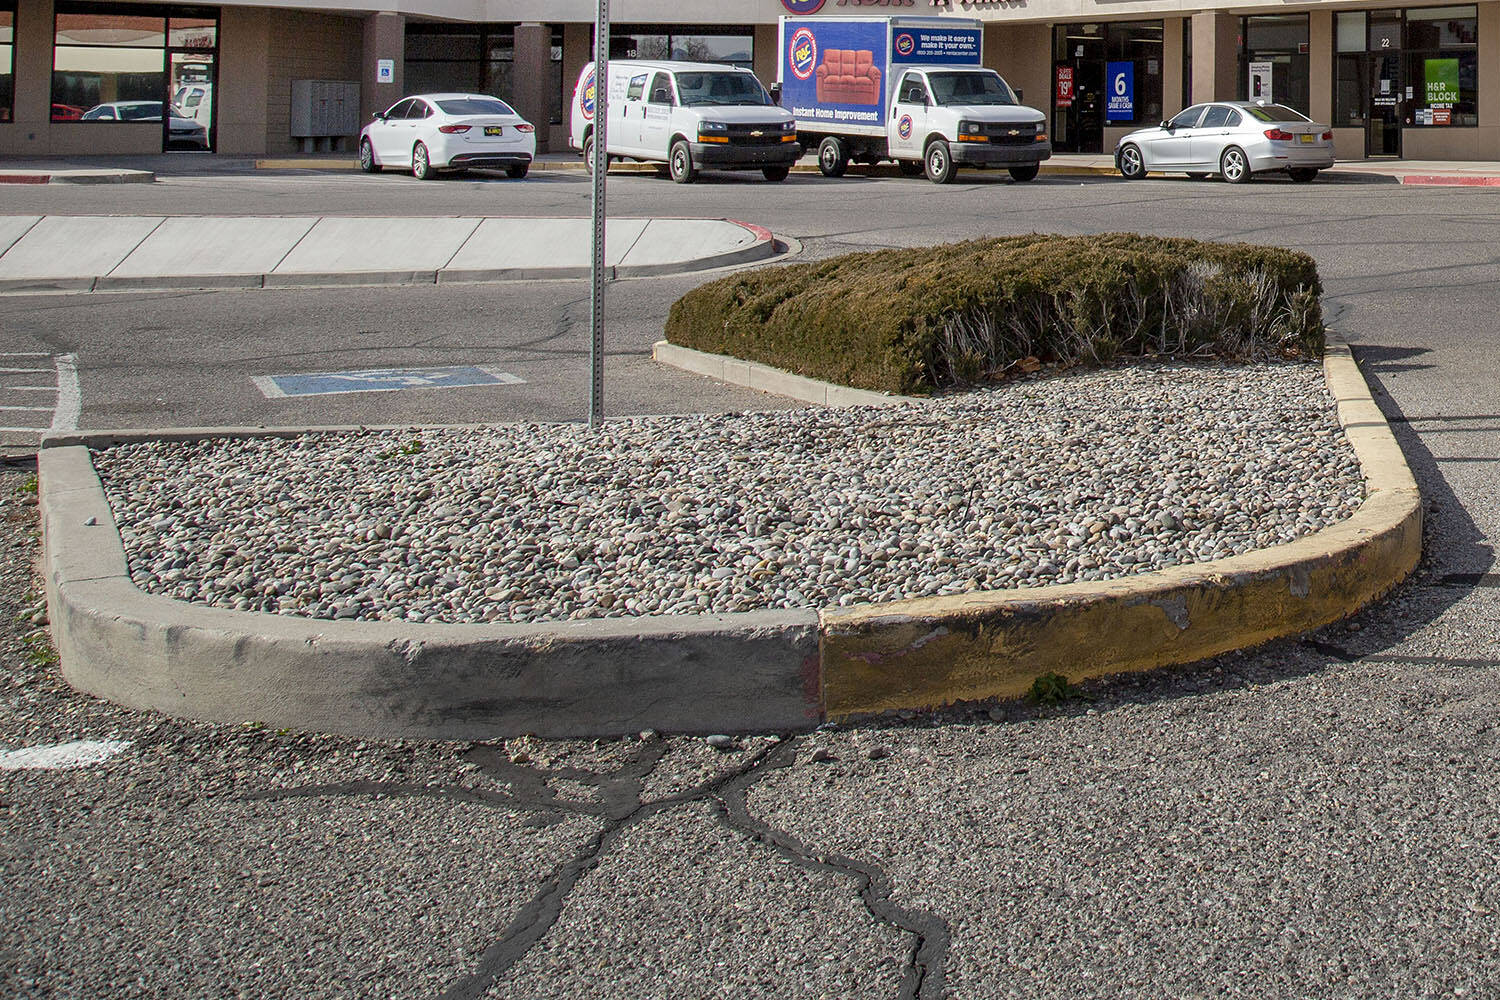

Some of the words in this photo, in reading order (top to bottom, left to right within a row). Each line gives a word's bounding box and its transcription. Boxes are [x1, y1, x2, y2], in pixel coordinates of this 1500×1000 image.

[920, 34, 930, 42] We
[1381, 38, 1390, 48] 22
[795, 44, 811, 62] RAC
[1114, 72, 1126, 96] 6
[1427, 82, 1446, 91] H&R
[1427, 92, 1457, 101] BLOCK
[793, 107, 815, 117] Instant
[815, 108, 833, 118] Home
[835, 109, 878, 121] Improvement
